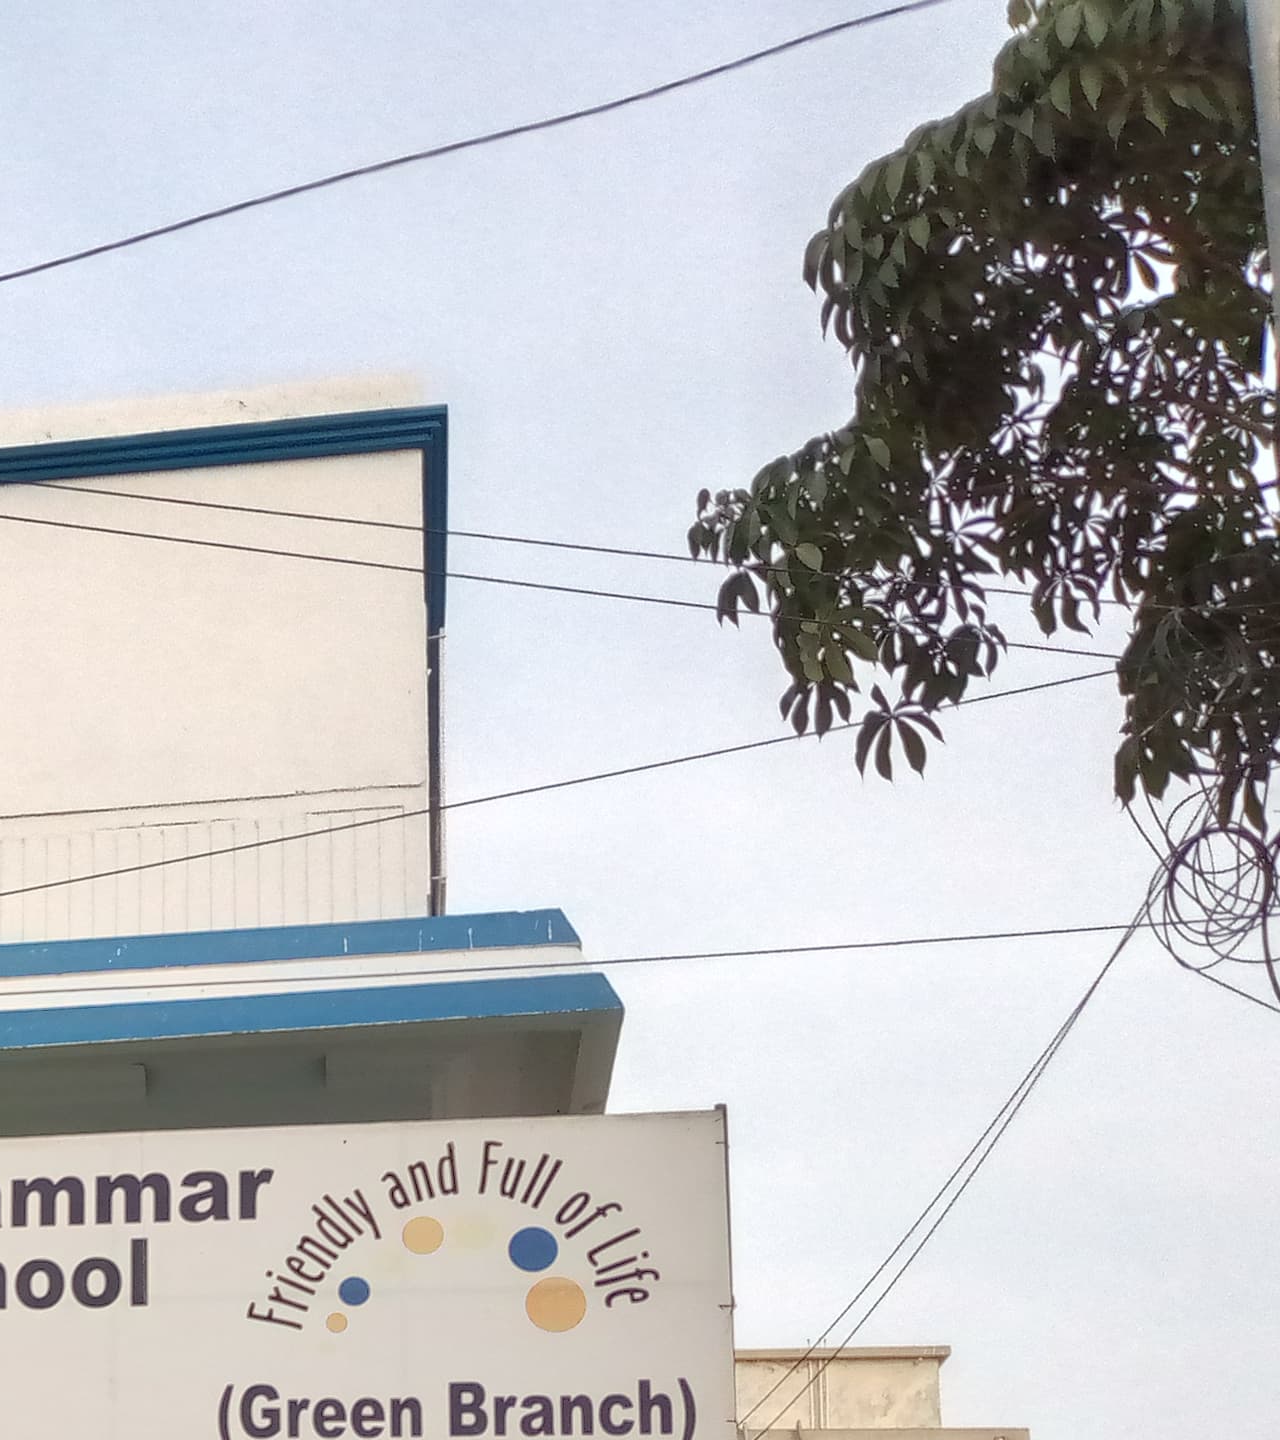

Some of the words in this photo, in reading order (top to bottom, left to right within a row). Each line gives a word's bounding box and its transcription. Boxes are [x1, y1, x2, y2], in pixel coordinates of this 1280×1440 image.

[381, 1142, 458, 1209] and
[479, 1141, 563, 1209] Full
[556, 1192, 622, 1239] of
[247, 1189, 382, 1330] Friendly
[587, 1228, 660, 1308] Life
